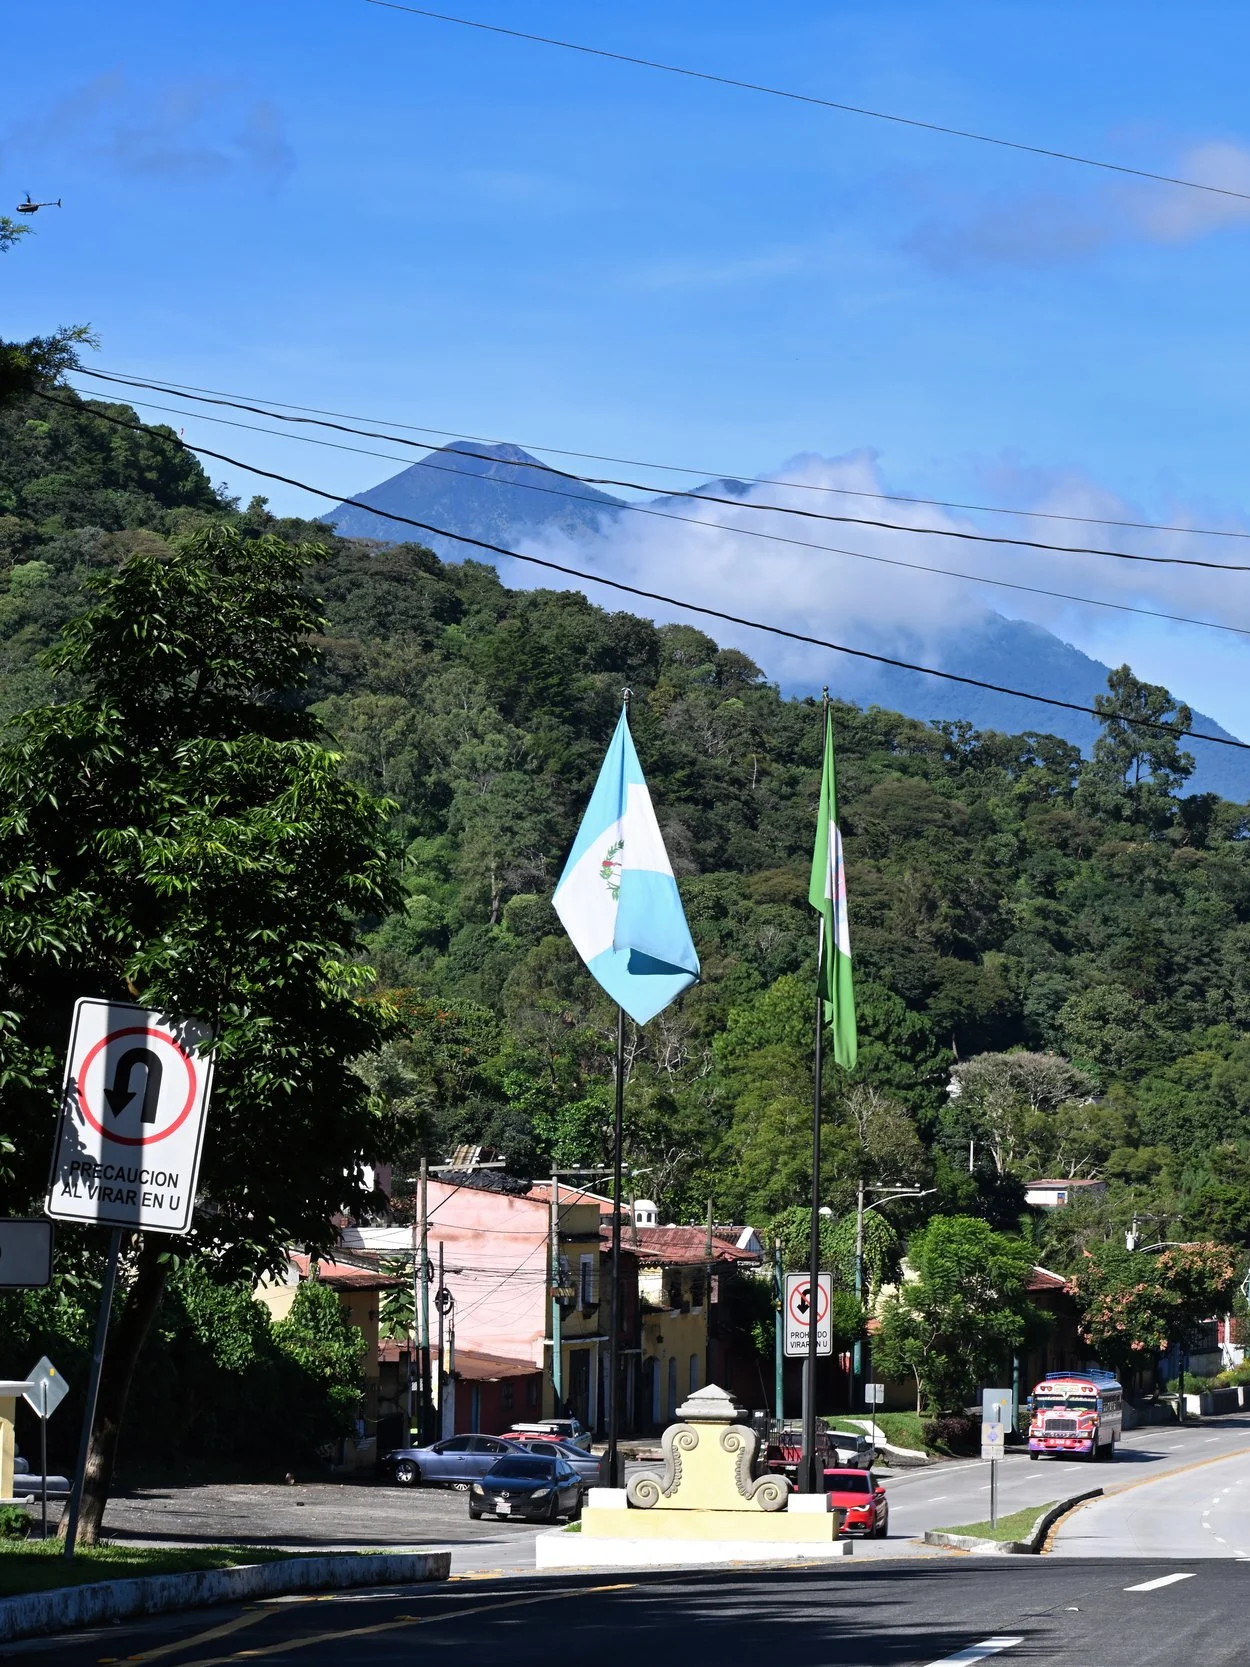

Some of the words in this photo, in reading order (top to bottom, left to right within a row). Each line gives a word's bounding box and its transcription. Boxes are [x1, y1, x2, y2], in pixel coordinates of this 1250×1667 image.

[70, 1161, 178, 1188] PRECAUCION
[60, 1182, 82, 1199] AL
[87, 1184, 138, 1206] VIRAR
[141, 1191, 164, 1209] EN
[168, 1195, 181, 1211] U
